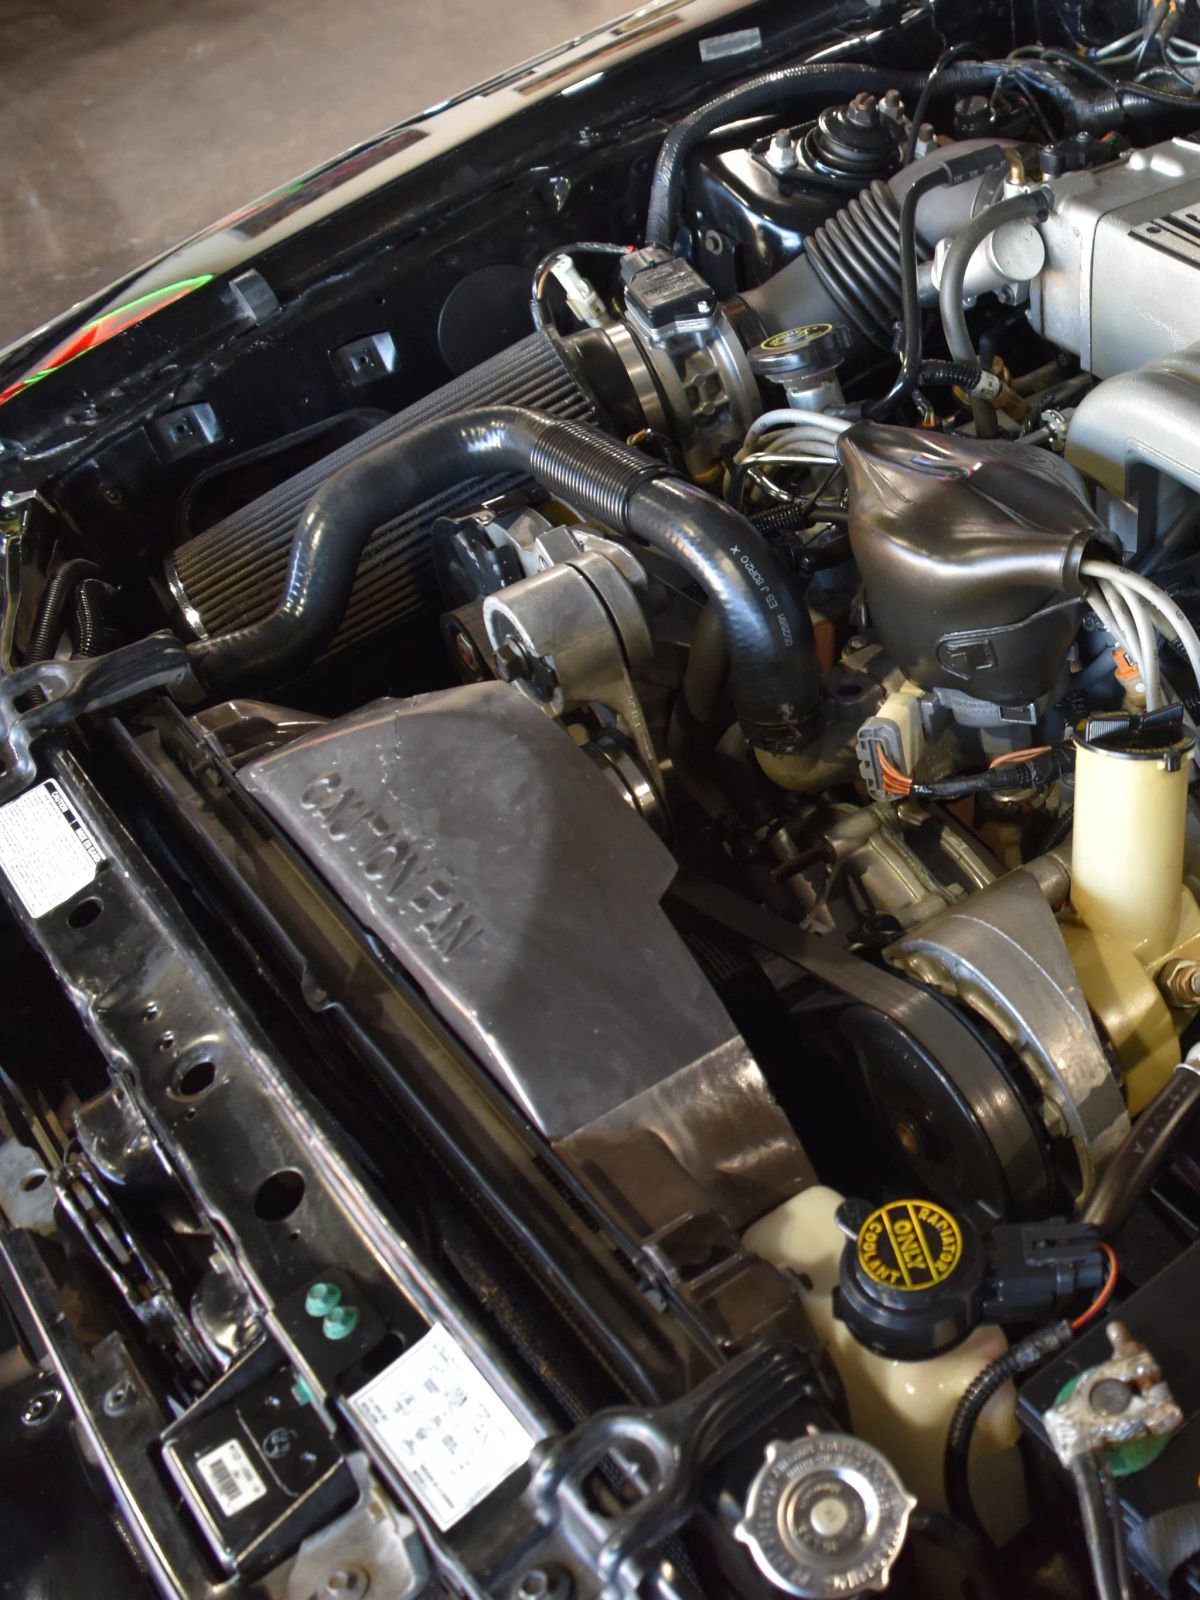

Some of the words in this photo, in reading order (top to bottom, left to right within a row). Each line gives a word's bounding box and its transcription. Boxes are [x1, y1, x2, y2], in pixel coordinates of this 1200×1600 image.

[729, 544, 741, 556] X
[50, 789, 69, 813] CAUTION
[301, 771, 419, 903] CAUTION
[398, 878, 485, 963] FAN
[862, 1221, 901, 1284] COOLANT
[893, 1220, 928, 1269] ONLY
[918, 1207, 957, 1273] RADIATOR
